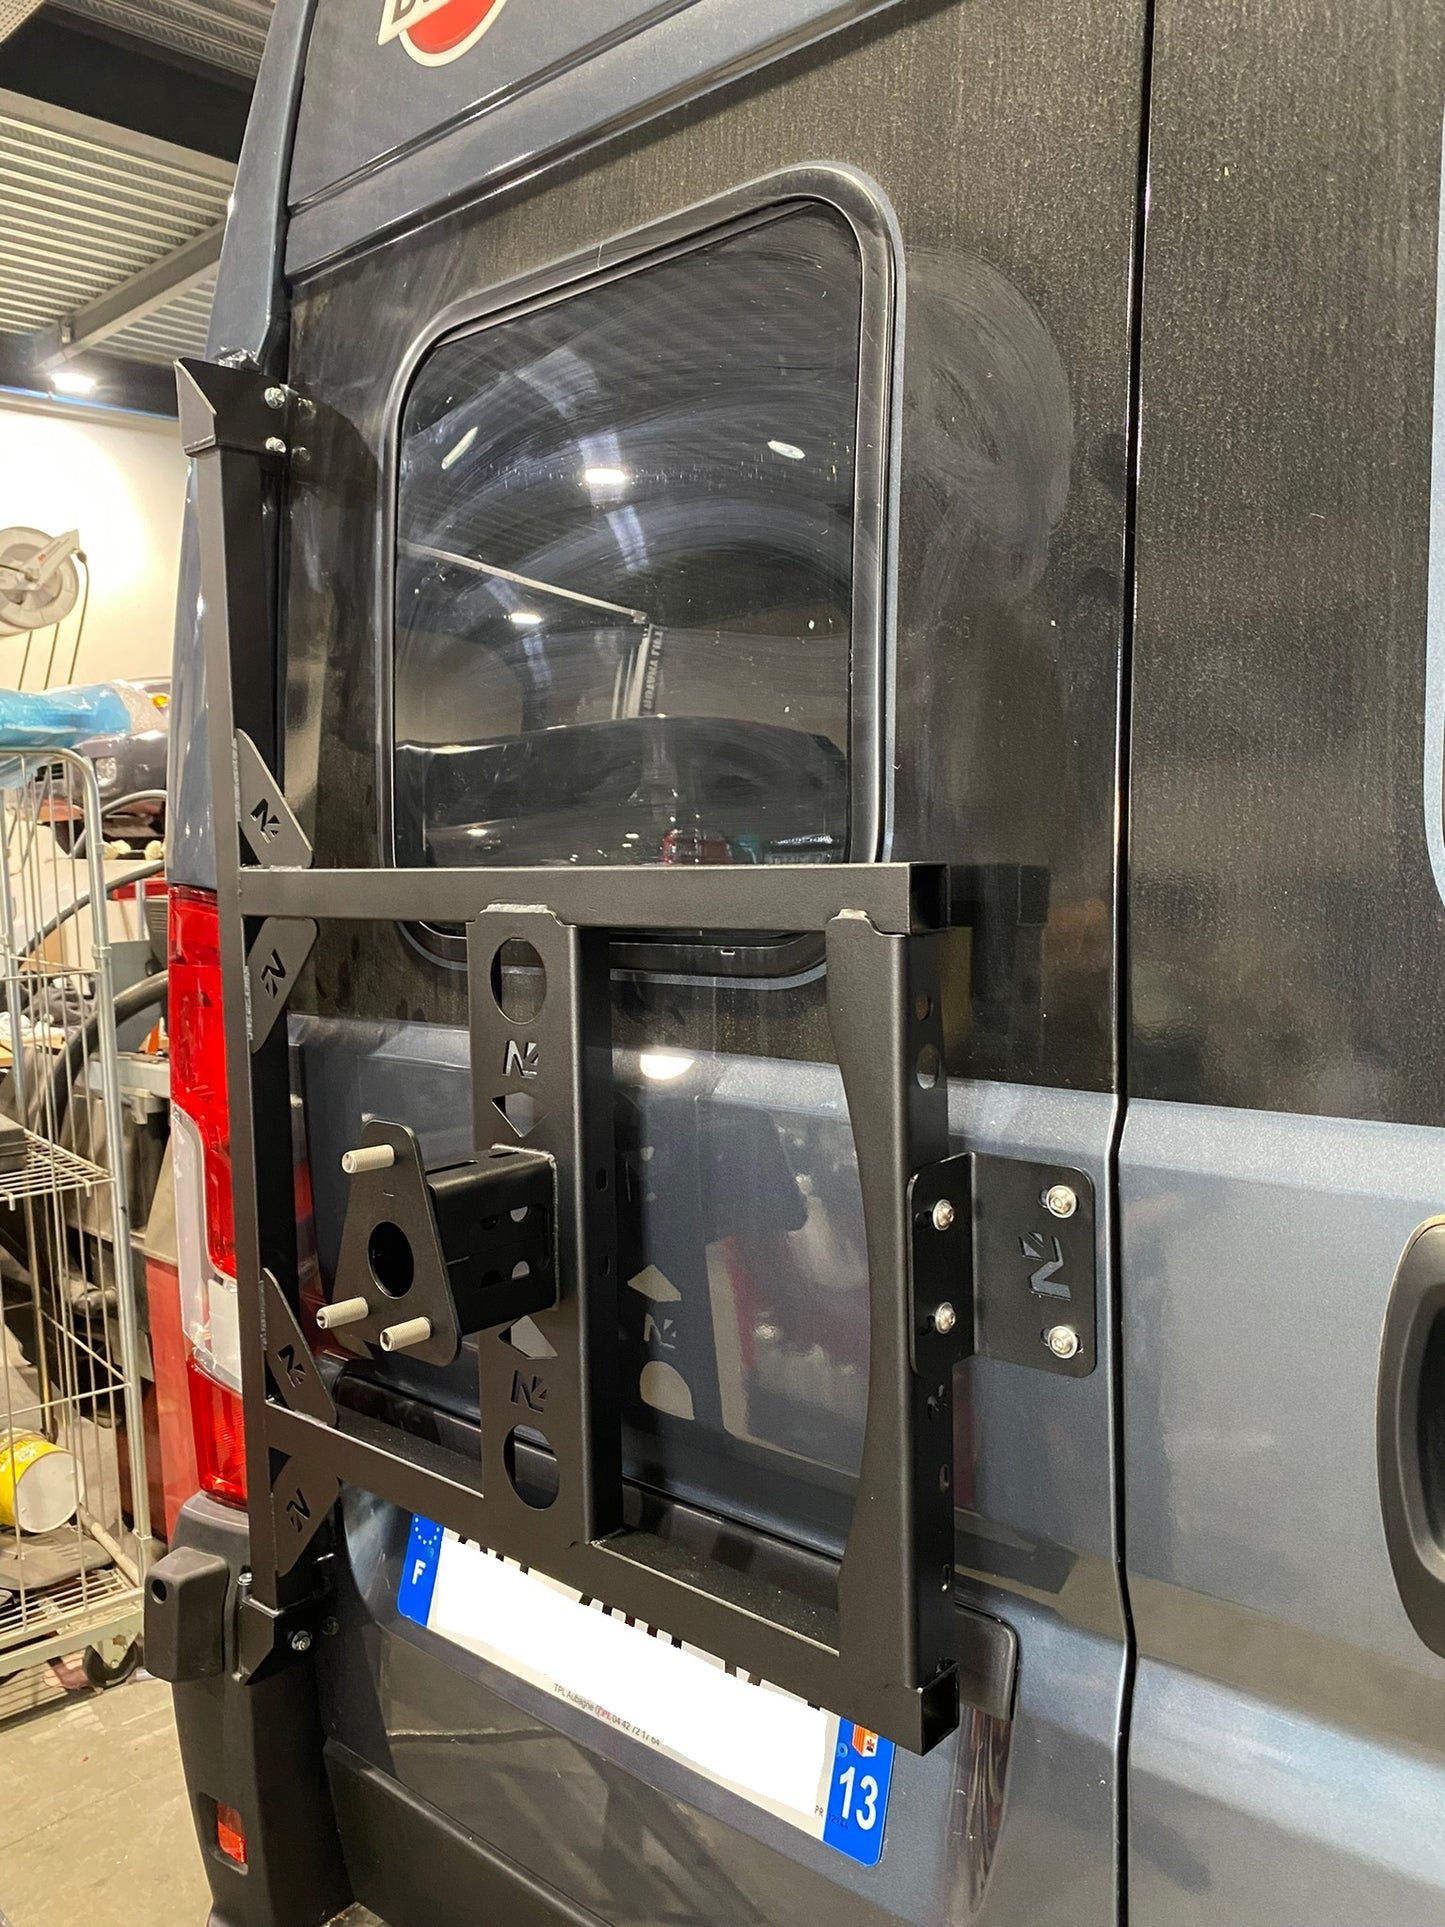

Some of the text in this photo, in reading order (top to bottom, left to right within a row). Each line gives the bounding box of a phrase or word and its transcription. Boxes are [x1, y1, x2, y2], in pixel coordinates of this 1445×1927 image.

[412, 1559, 427, 1585] F
[814, 1805, 825, 1817] PR
[839, 1766, 879, 1830] 13
